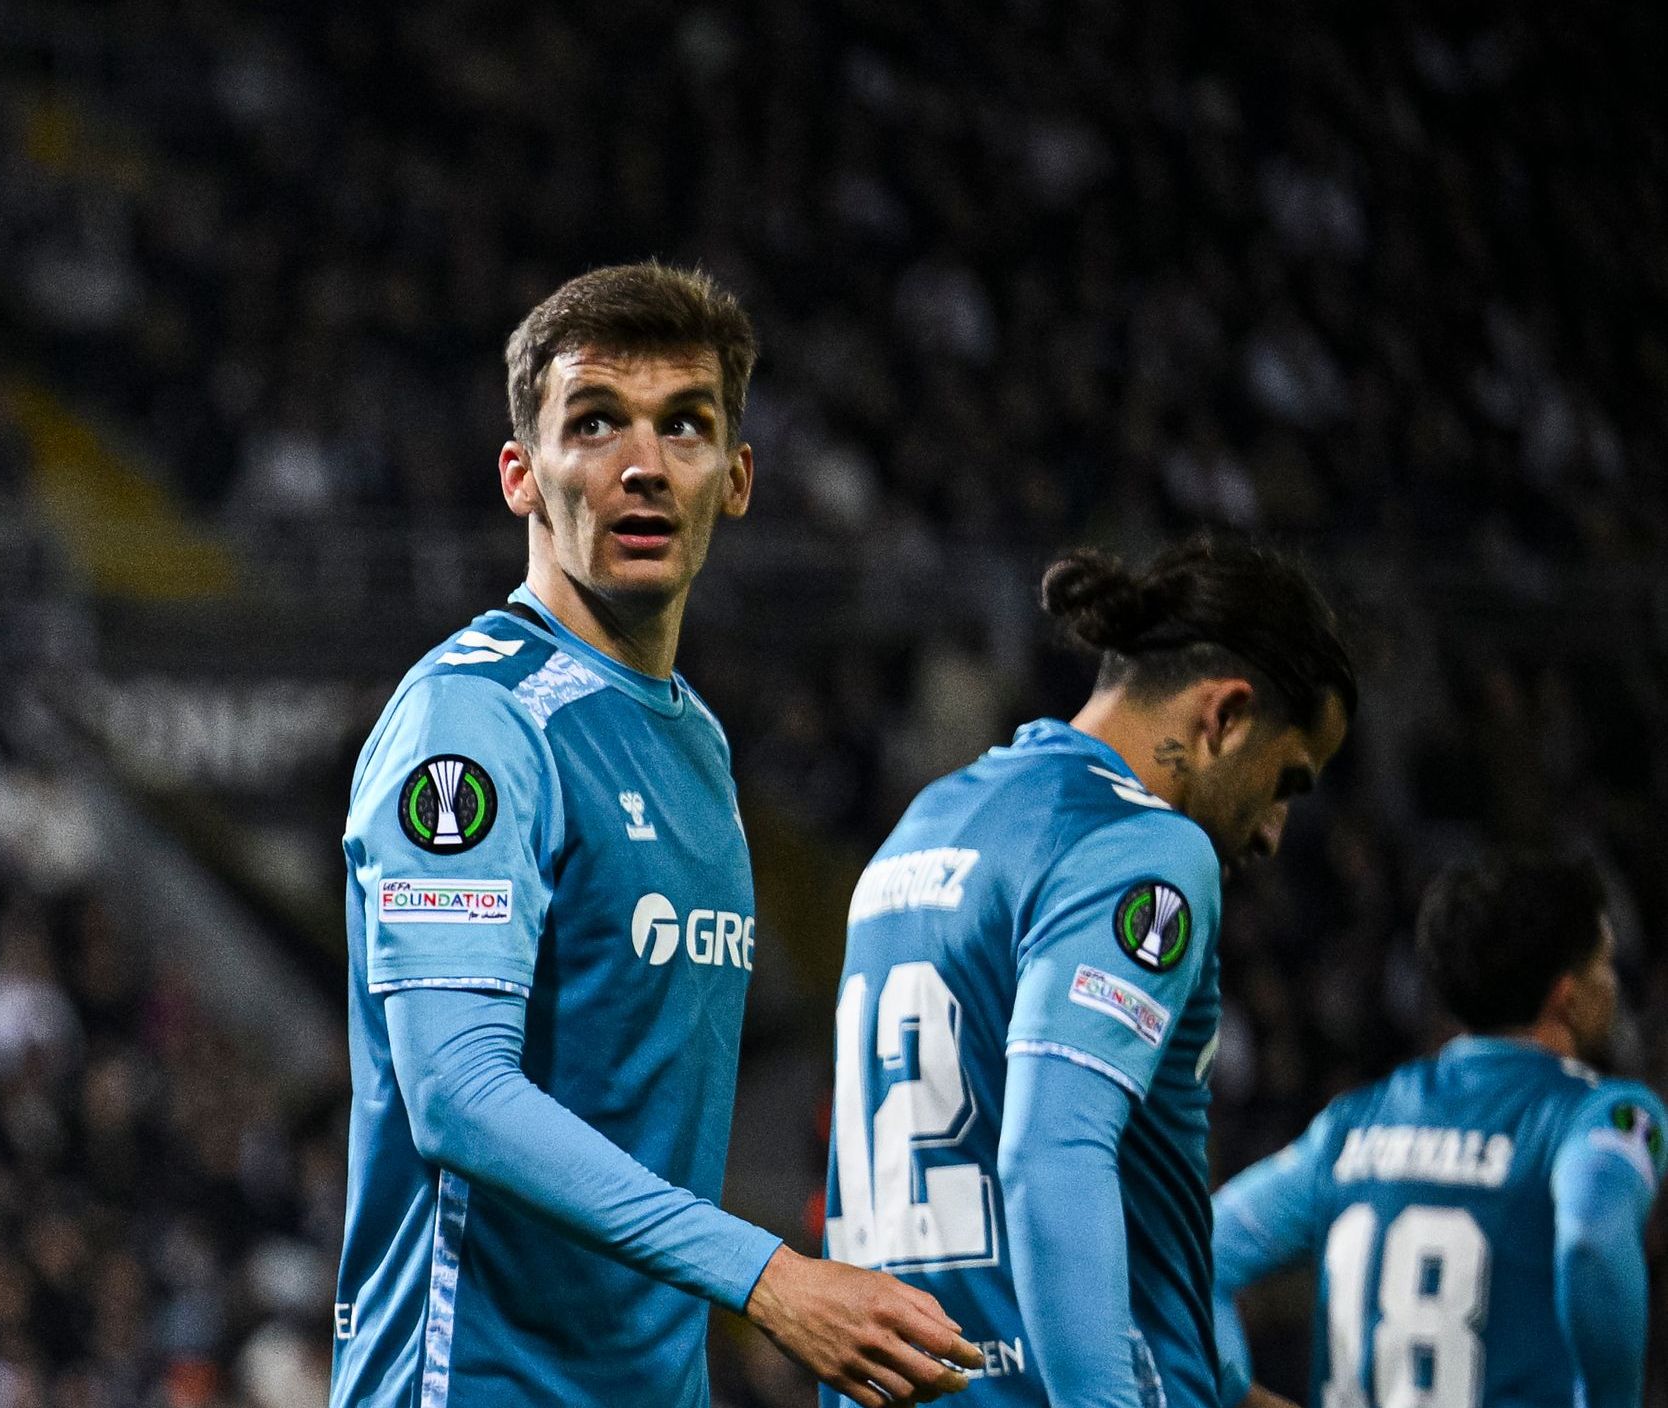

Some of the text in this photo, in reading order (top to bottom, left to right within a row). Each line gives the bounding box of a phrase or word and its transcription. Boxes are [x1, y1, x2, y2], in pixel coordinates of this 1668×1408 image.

[383, 882, 411, 892] UEFA
[382, 893, 508, 908] FOUNDATION
[826, 961, 1000, 1273] 12
